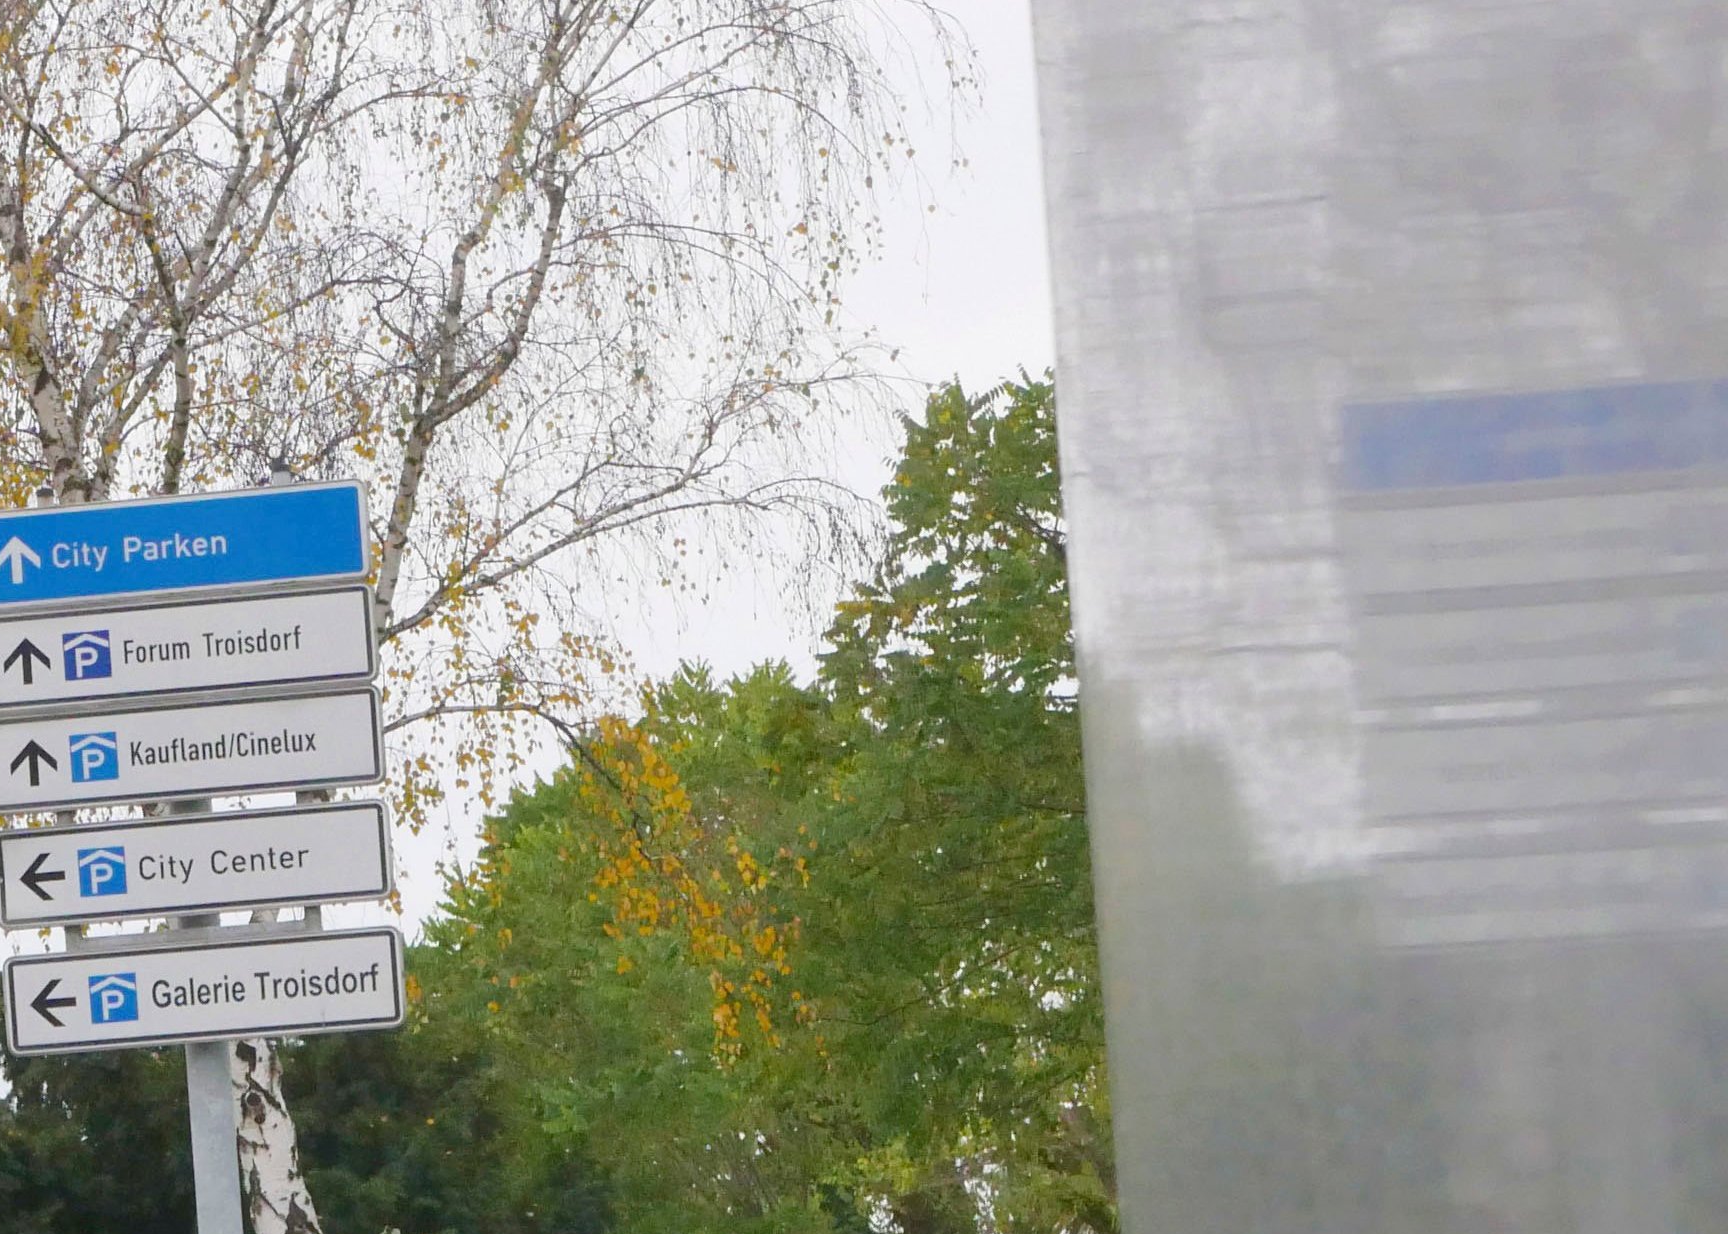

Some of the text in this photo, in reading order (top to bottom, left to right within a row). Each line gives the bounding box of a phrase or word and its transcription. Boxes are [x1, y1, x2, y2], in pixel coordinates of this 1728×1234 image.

[52, 533, 228, 573] City Parken
[74, 625, 302, 679] P Forum Troisdorf
[82, 728, 317, 780] P Kaufland/Cinelux
[90, 847, 310, 895] P City Center
[101, 962, 380, 1021] P Galerie Troisdorf
